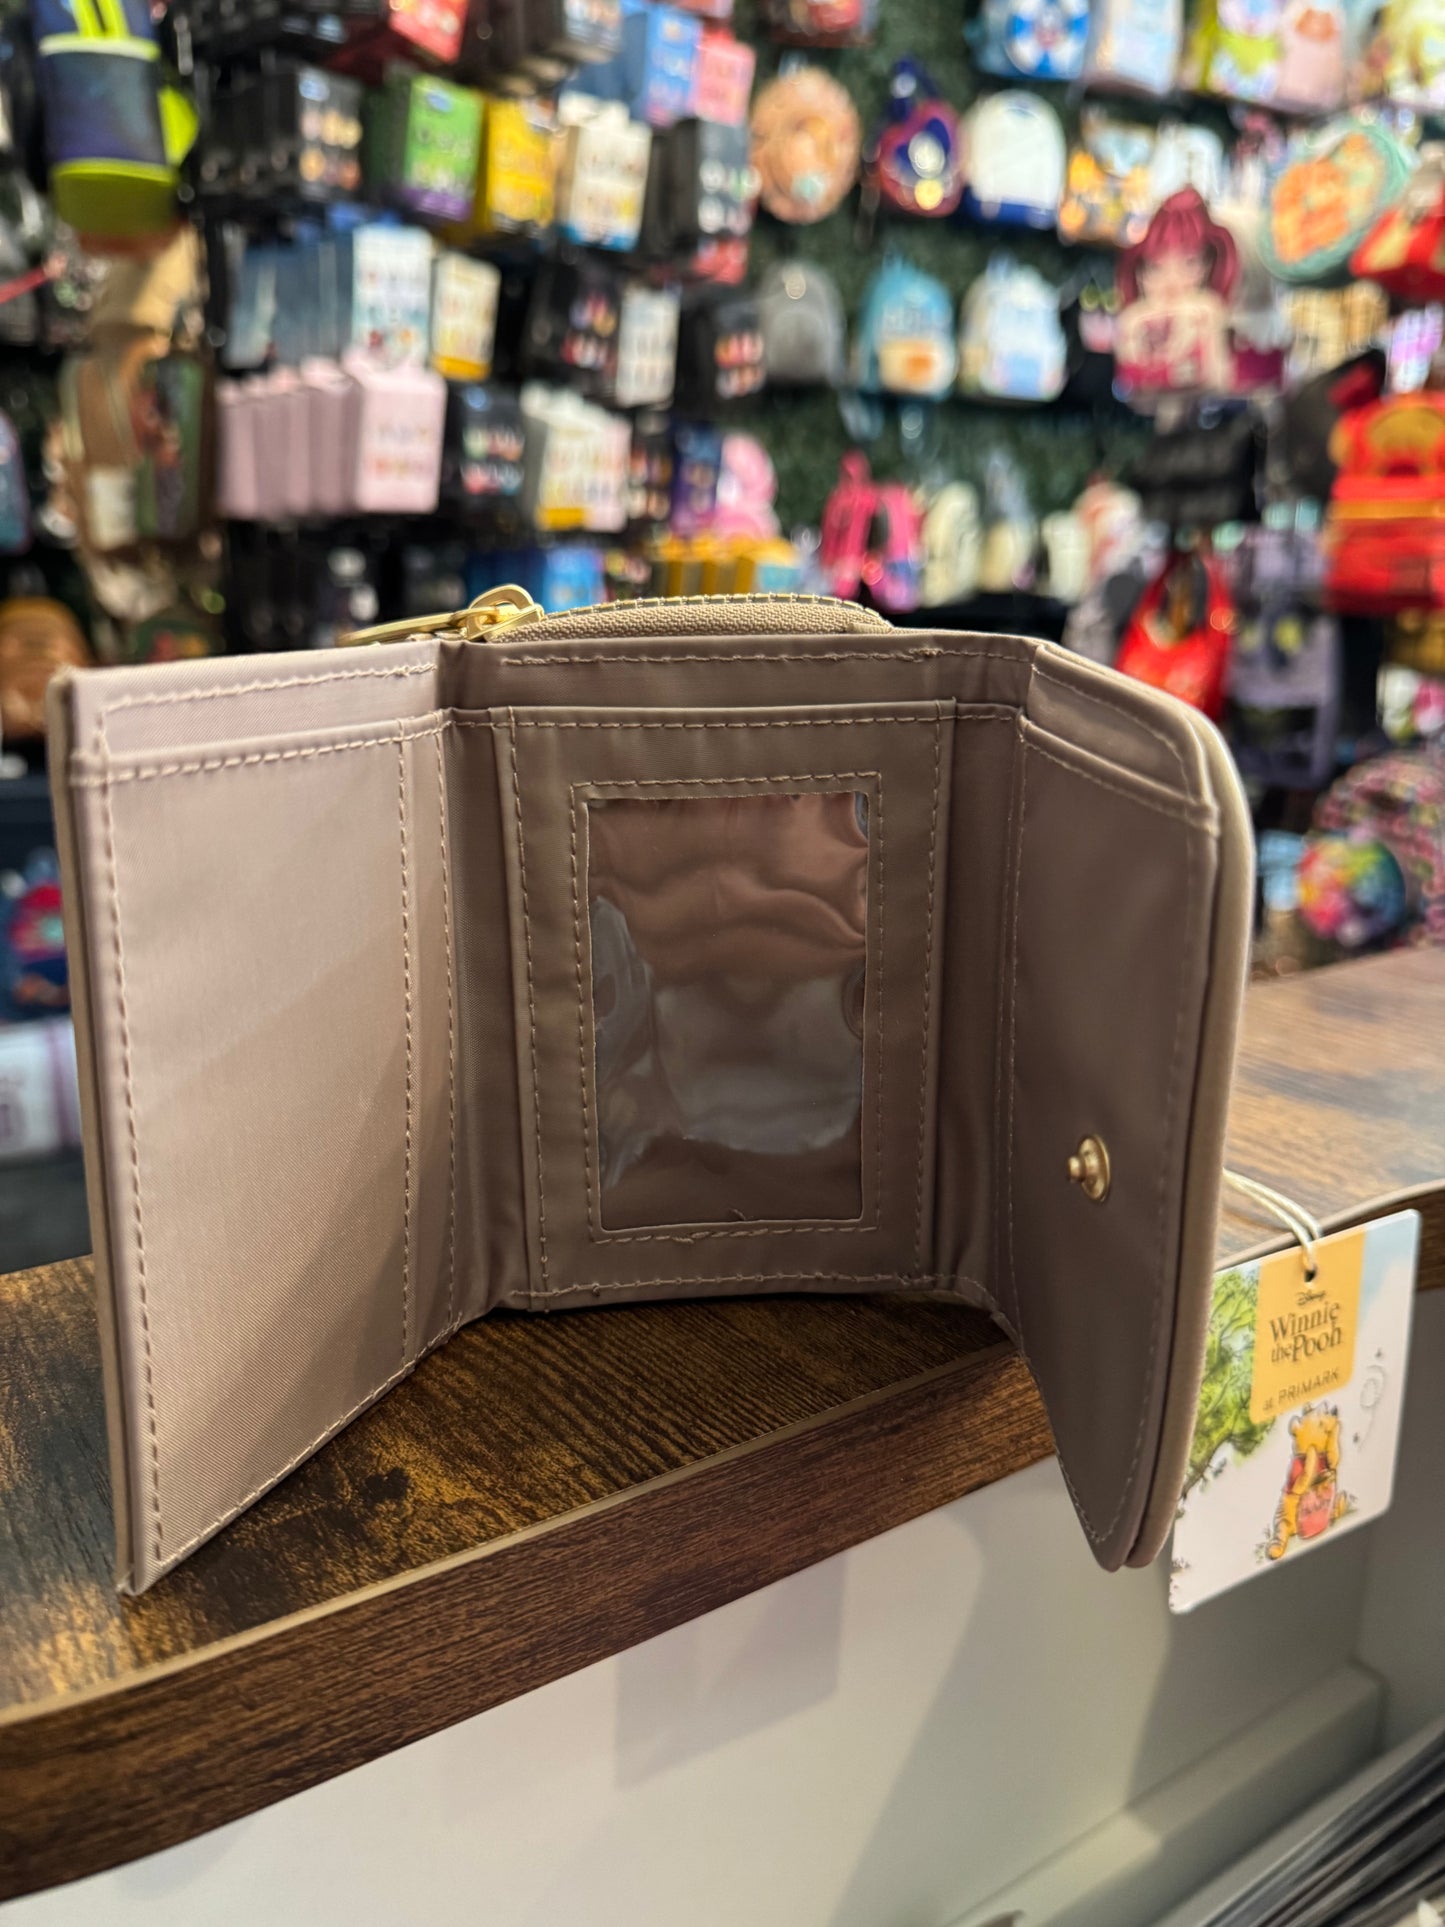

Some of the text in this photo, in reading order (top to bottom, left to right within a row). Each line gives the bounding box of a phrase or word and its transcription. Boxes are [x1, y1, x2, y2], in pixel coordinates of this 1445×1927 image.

[1269, 1301, 1341, 1342] Winnie
[1271, 1321, 1342, 1363] the Pooh
[1278, 1368, 1339, 1403] PRIMARK
